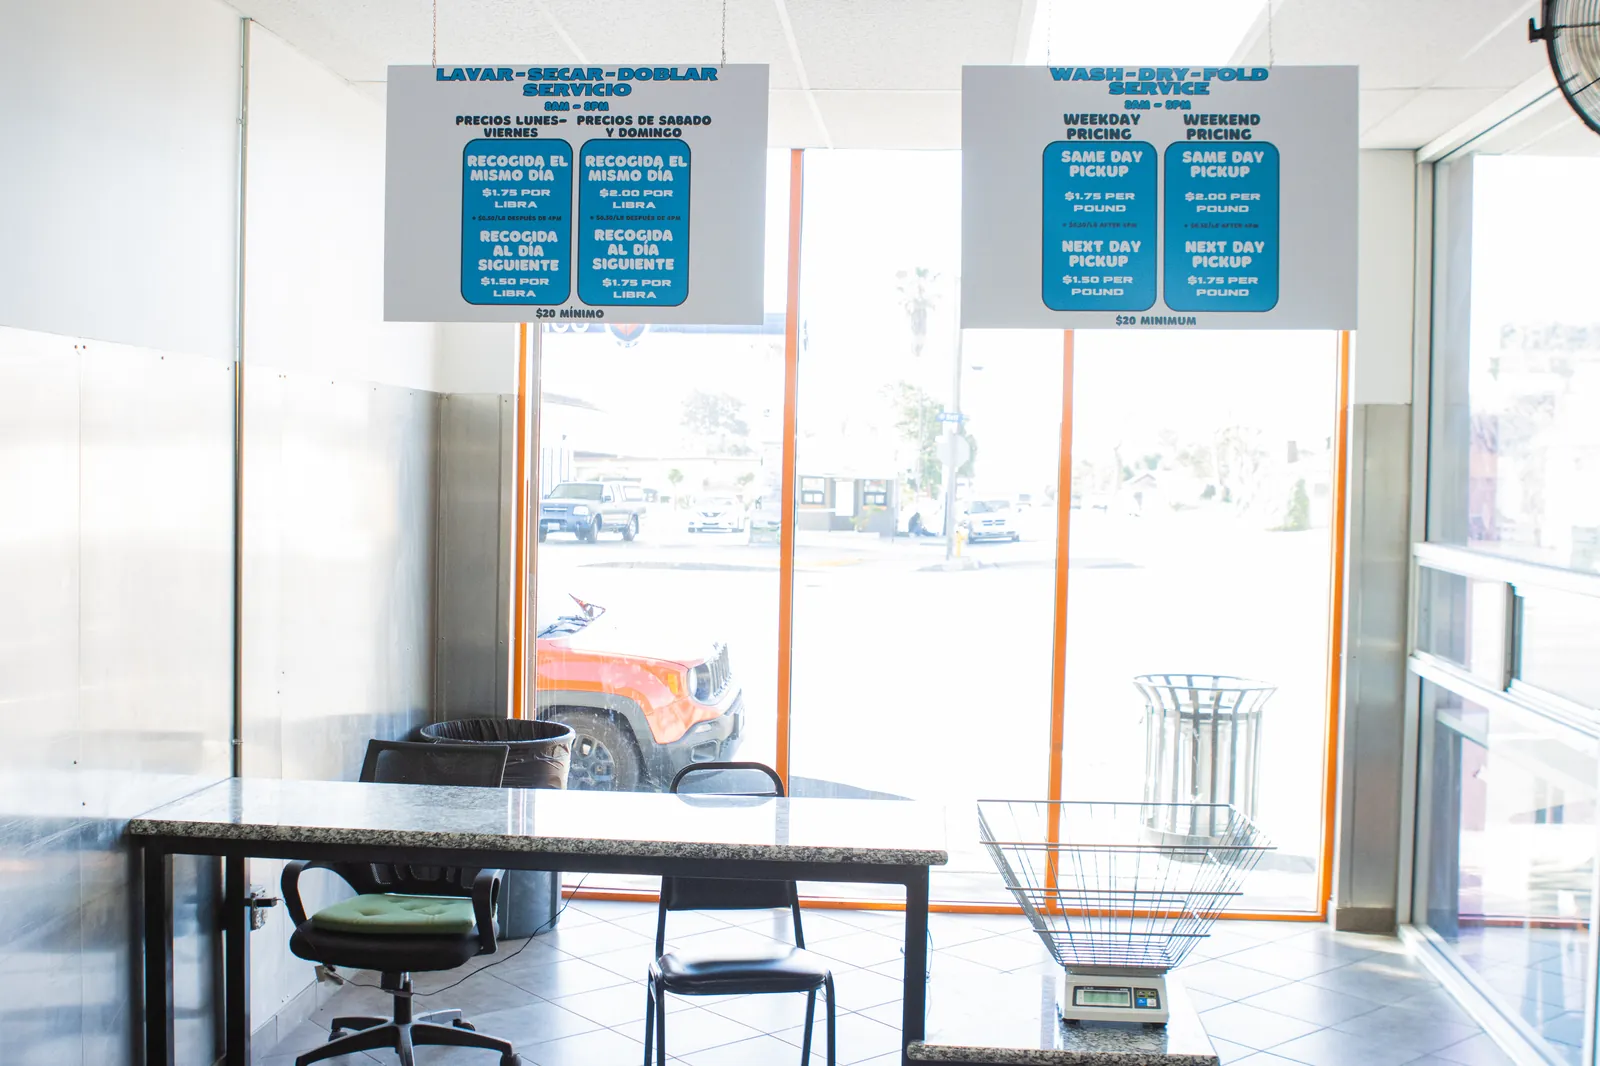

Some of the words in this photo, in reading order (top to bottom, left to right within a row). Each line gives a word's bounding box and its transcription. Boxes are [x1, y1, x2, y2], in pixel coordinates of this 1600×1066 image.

[523, 83, 632, 97] SERVICIO
[1109, 82, 1210, 95] SERVICE
[544, 101, 570, 111] 8AM
[584, 101, 609, 111] 8PM
[1124, 100, 1150, 110] 8AM
[1165, 100, 1191, 110] 8PM
[456, 116, 511, 125] PRECIOS
[577, 115, 633, 125] PRECIOS
[638, 116, 654, 125] DE
[659, 116, 711, 125] SABADO
[1064, 114, 1140, 125] WEEKDAY
[1184, 114, 1260, 125] WEEKEND
[484, 127, 538, 138] VIERNES
[606, 127, 616, 138] Y
[619, 127, 682, 138] DOMINGO
[1067, 128, 1132, 140] PRICING
[1187, 128, 1252, 140] PRICING
[468, 155, 545, 167] RECOGIDA
[550, 156, 568, 167] EL
[586, 155, 664, 167] RECOGIDA
[669, 156, 687, 167] EL
[1061, 151, 1105, 162] SAME
[1111, 151, 1142, 163] DAY
[1182, 151, 1226, 163] SAME
[1232, 151, 1264, 163] DAY
[470, 169, 522, 181] MISMO
[528, 166, 555, 181] DÍA
[588, 169, 642, 181] MISMO
[647, 166, 673, 181] DÍA
[1070, 165, 1128, 177] PICKUP
[1191, 165, 1250, 177] PICKUP
[482, 188, 517, 197] $1.75
[600, 188, 639, 198] $2.00
[1065, 191, 1101, 201] $1.75
[1185, 192, 1227, 201] $2.00
[480, 230, 558, 242] RECOGIDA
[595, 229, 673, 242] RECOGIDA
[493, 244, 513, 256] AL
[518, 241, 544, 256] DÍA
[608, 244, 628, 255] AL
[633, 241, 659, 256] DÍA
[1062, 240, 1103, 252] NEXT
[1109, 241, 1141, 253] DAY
[1185, 241, 1227, 253] NEXT
[1233, 241, 1264, 253] DAY
[478, 259, 559, 271] SIGUIENTE
[592, 258, 674, 270] SIGUIENTE
[1069, 255, 1128, 267] PICKUP
[1192, 256, 1252, 268] PICKUP
[481, 277, 516, 286] $1.50
[603, 278, 638, 287] $1.75
[1063, 275, 1099, 284] $1.50
[1188, 275, 1224, 285] $1.75
[536, 308, 555, 319] $20
[560, 306, 604, 318] MÍNIMO
[1116, 315, 1136, 326] $20
[1141, 316, 1196, 325] MINIMUM
